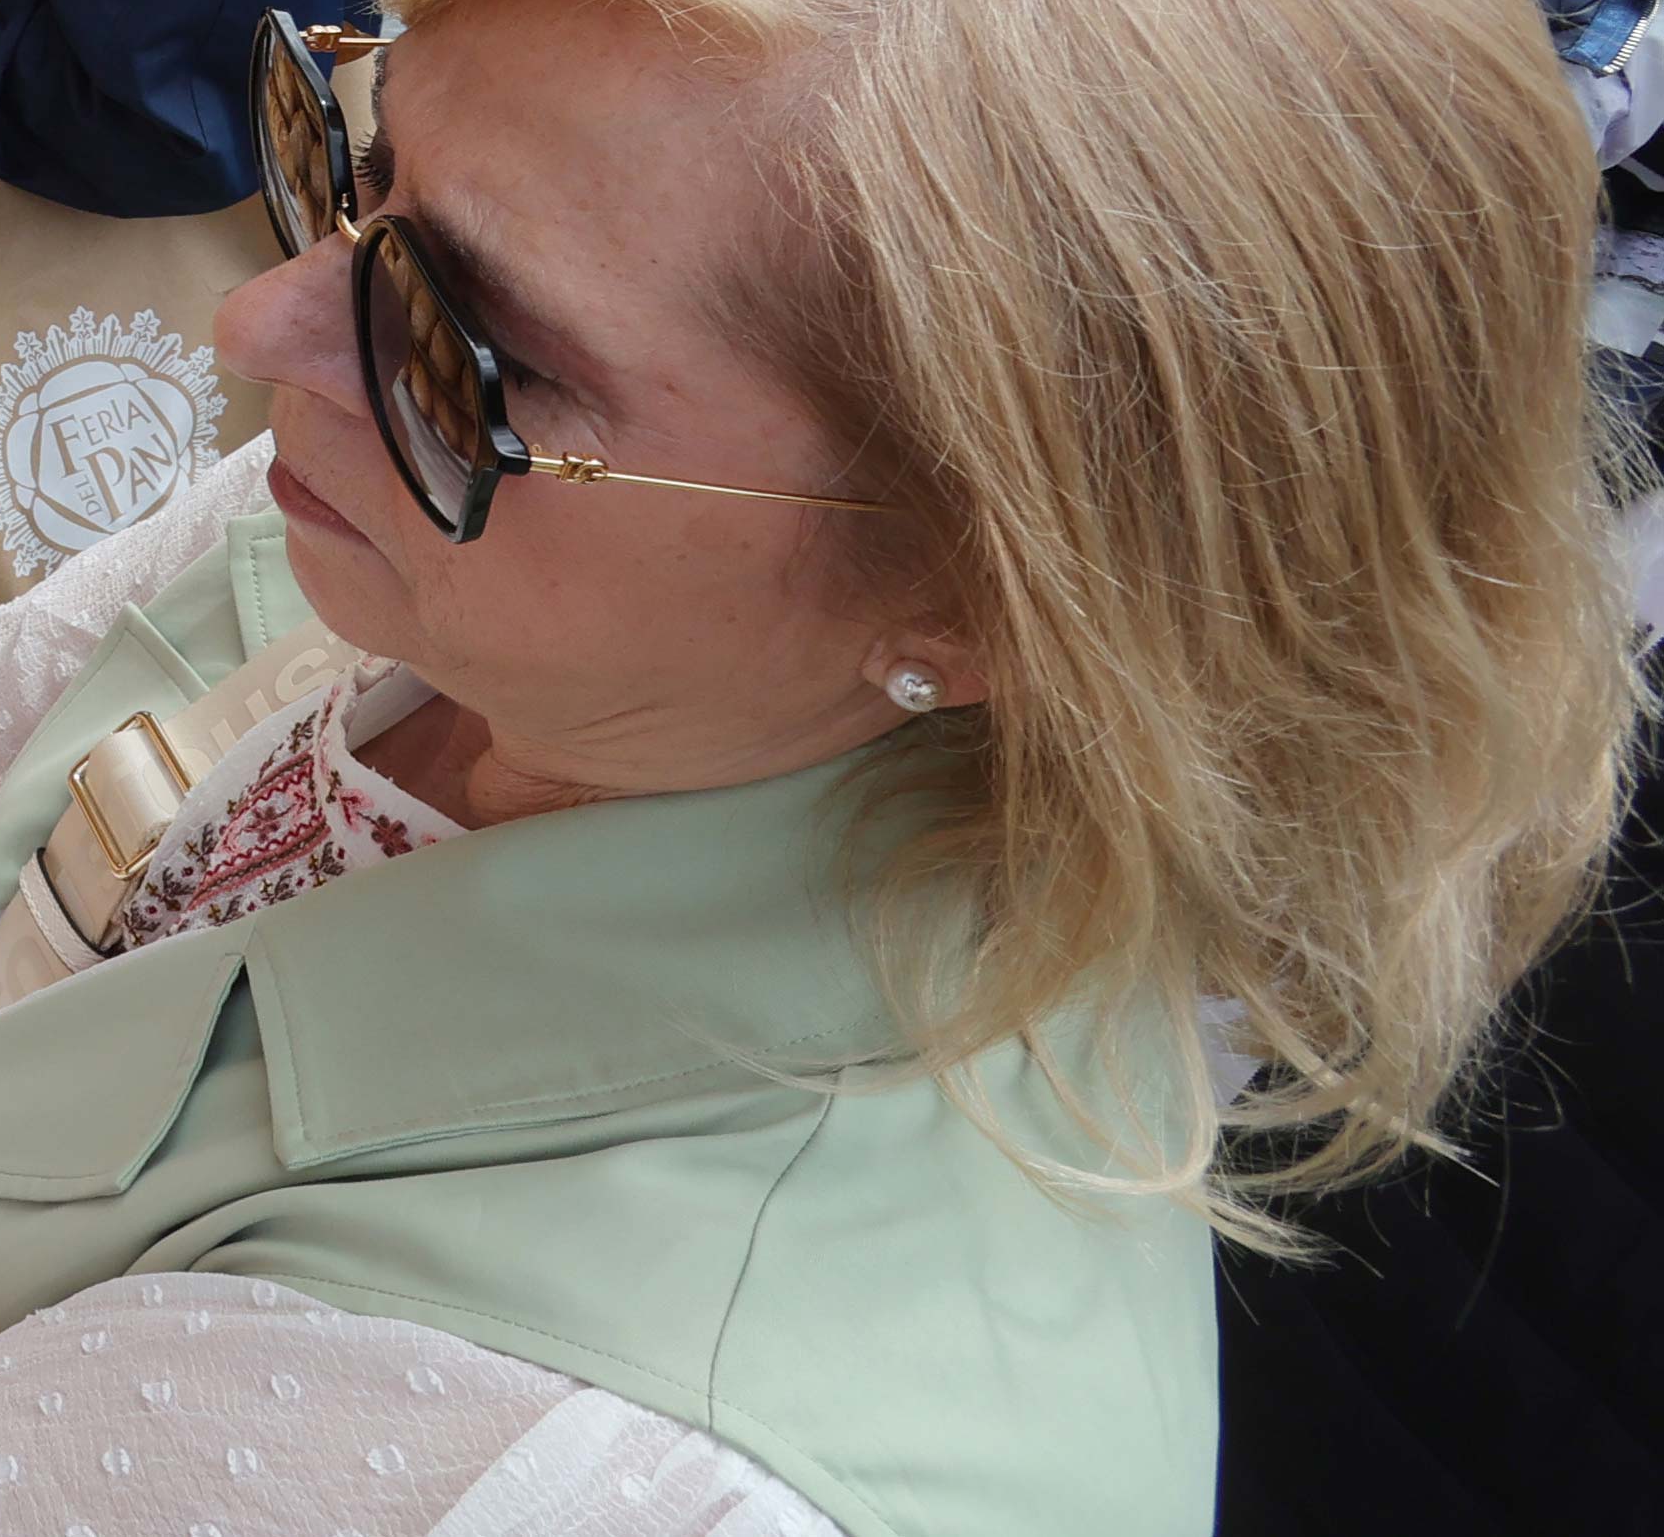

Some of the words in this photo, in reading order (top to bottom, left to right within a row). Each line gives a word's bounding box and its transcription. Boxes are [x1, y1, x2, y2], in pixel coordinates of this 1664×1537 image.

[48, 398, 152, 479] FERIA
[74, 474, 104, 517] DEL
[80, 432, 174, 527] PAN
